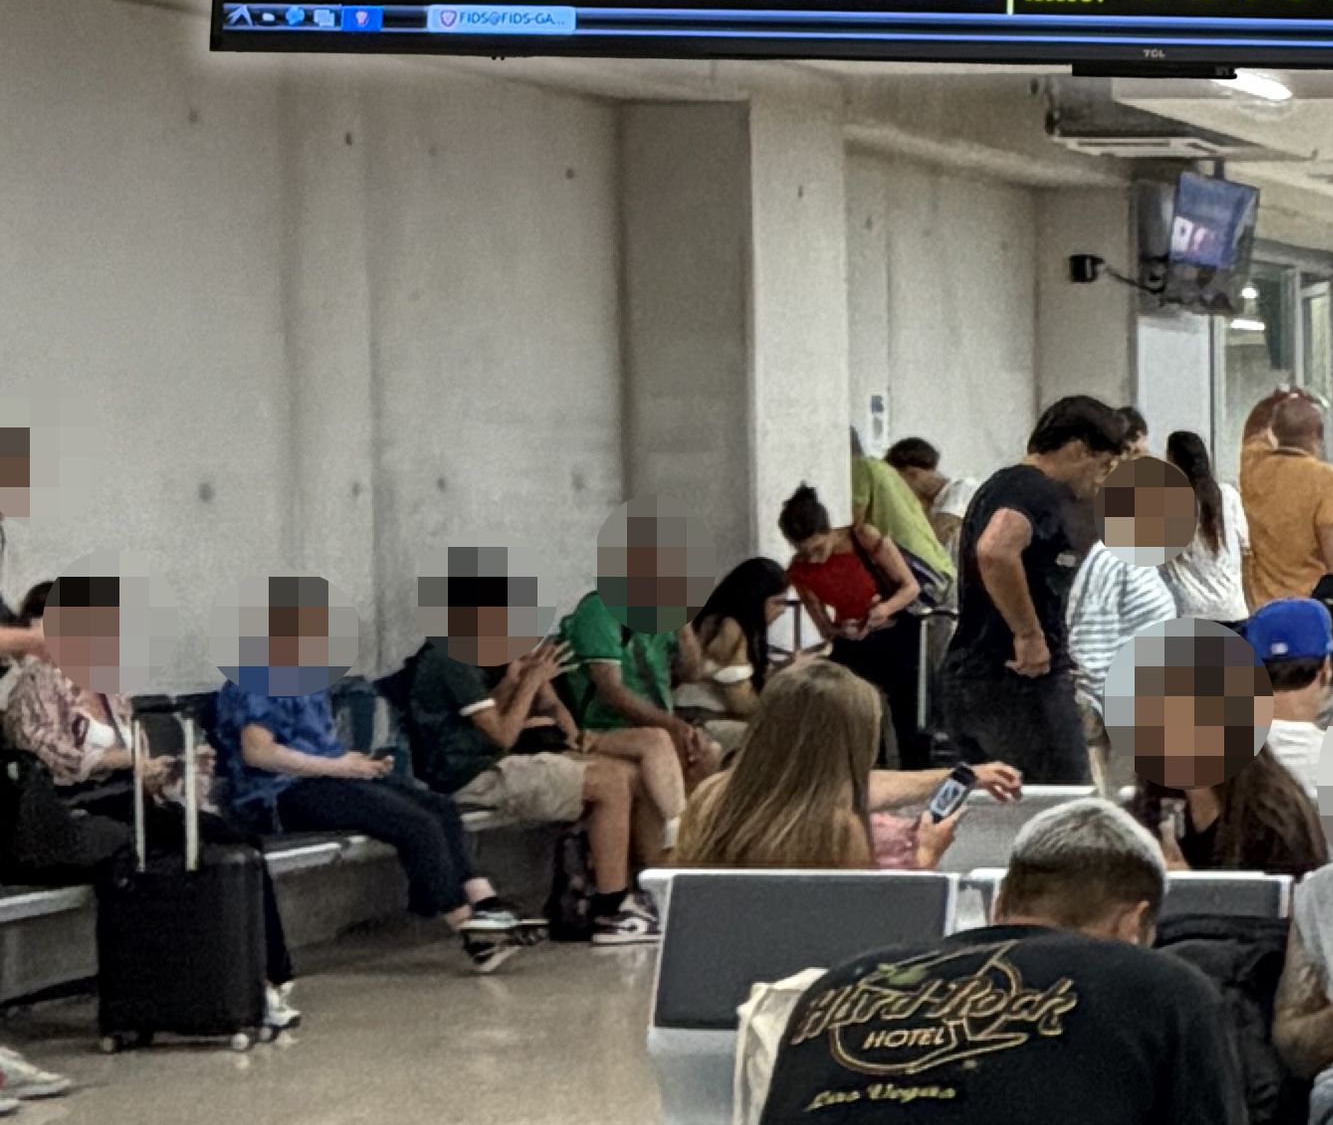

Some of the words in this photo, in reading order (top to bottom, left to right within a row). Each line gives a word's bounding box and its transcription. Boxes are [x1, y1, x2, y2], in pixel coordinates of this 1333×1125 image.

[861, 1028, 946, 1050] HOTEL
[804, 1089, 861, 1112] Las
[866, 1082, 955, 1104] Vegas
